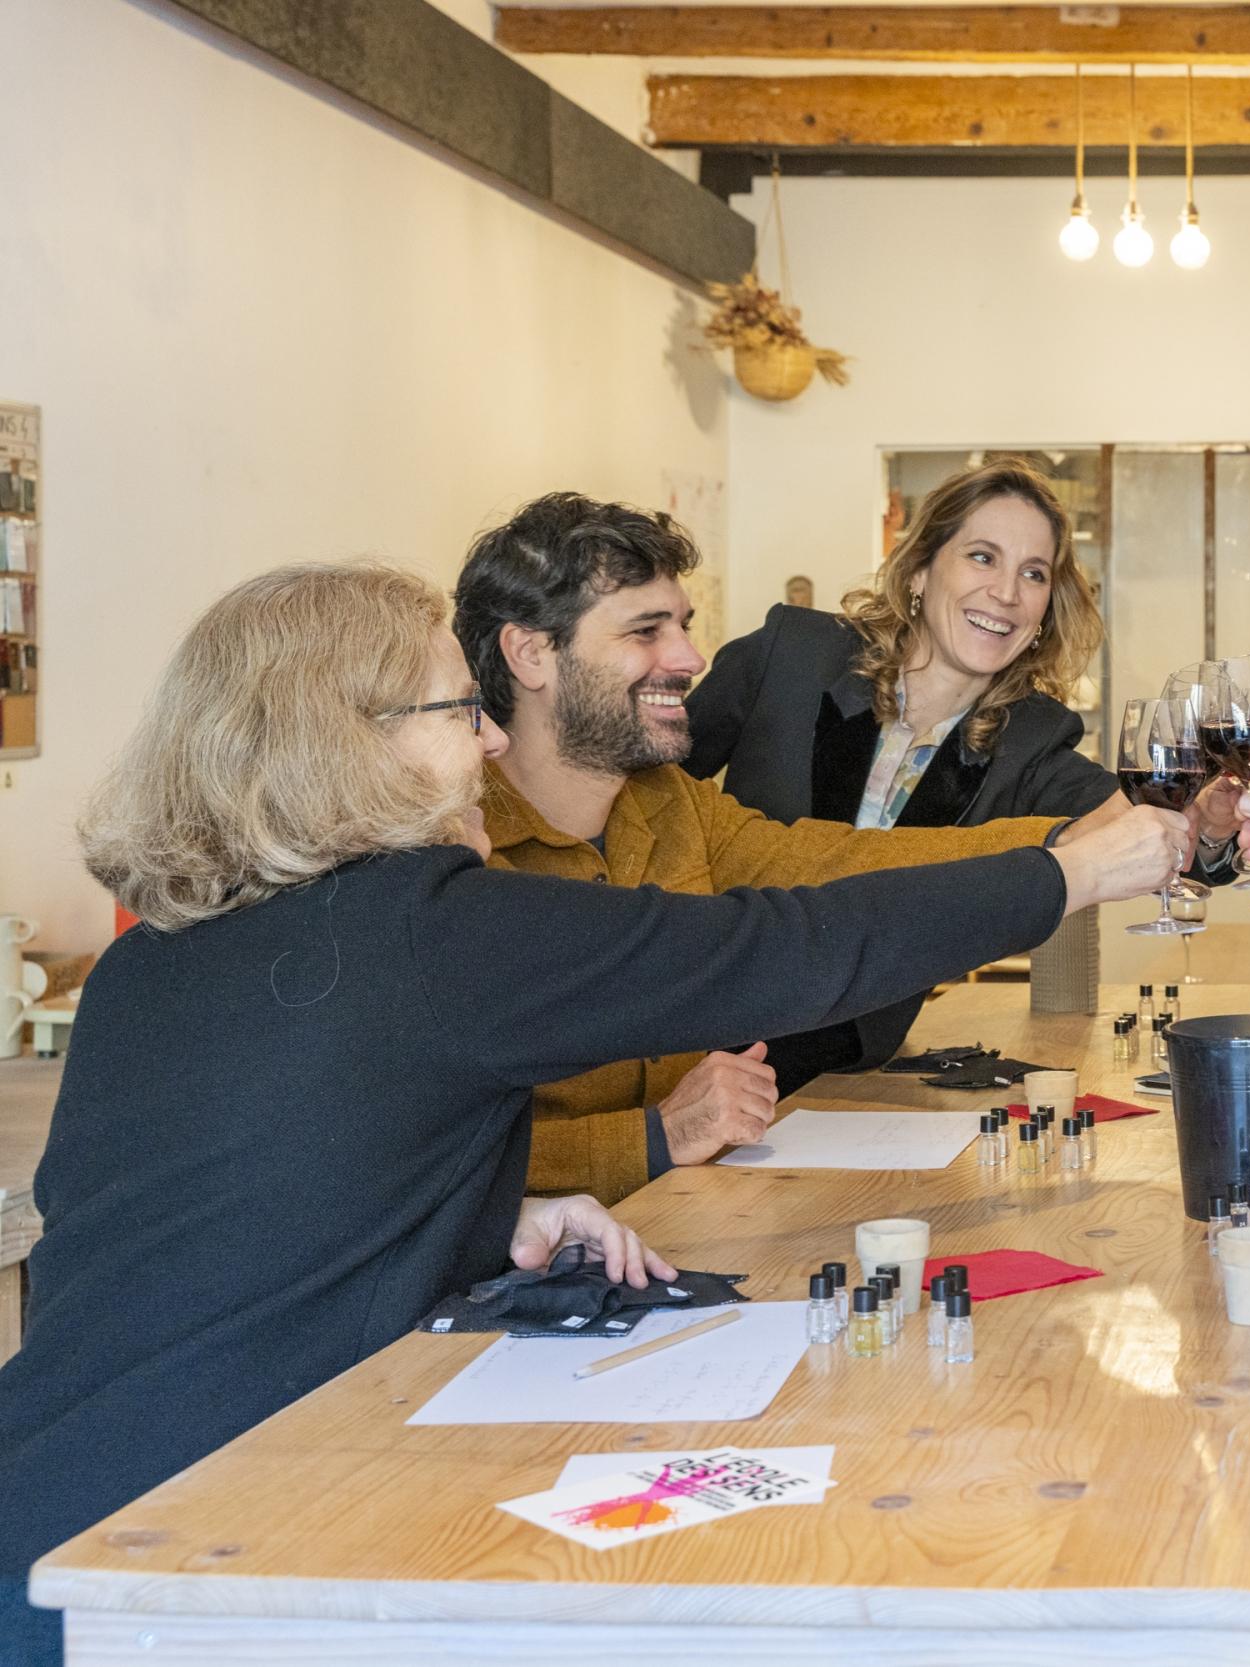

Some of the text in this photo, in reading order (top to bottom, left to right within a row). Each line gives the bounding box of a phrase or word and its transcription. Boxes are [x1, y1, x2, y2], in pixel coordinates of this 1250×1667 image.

[662, 1457, 722, 1479] DES
[709, 1475, 783, 1501] SENS
[704, 1452, 809, 1490] L'ÉCOLE
